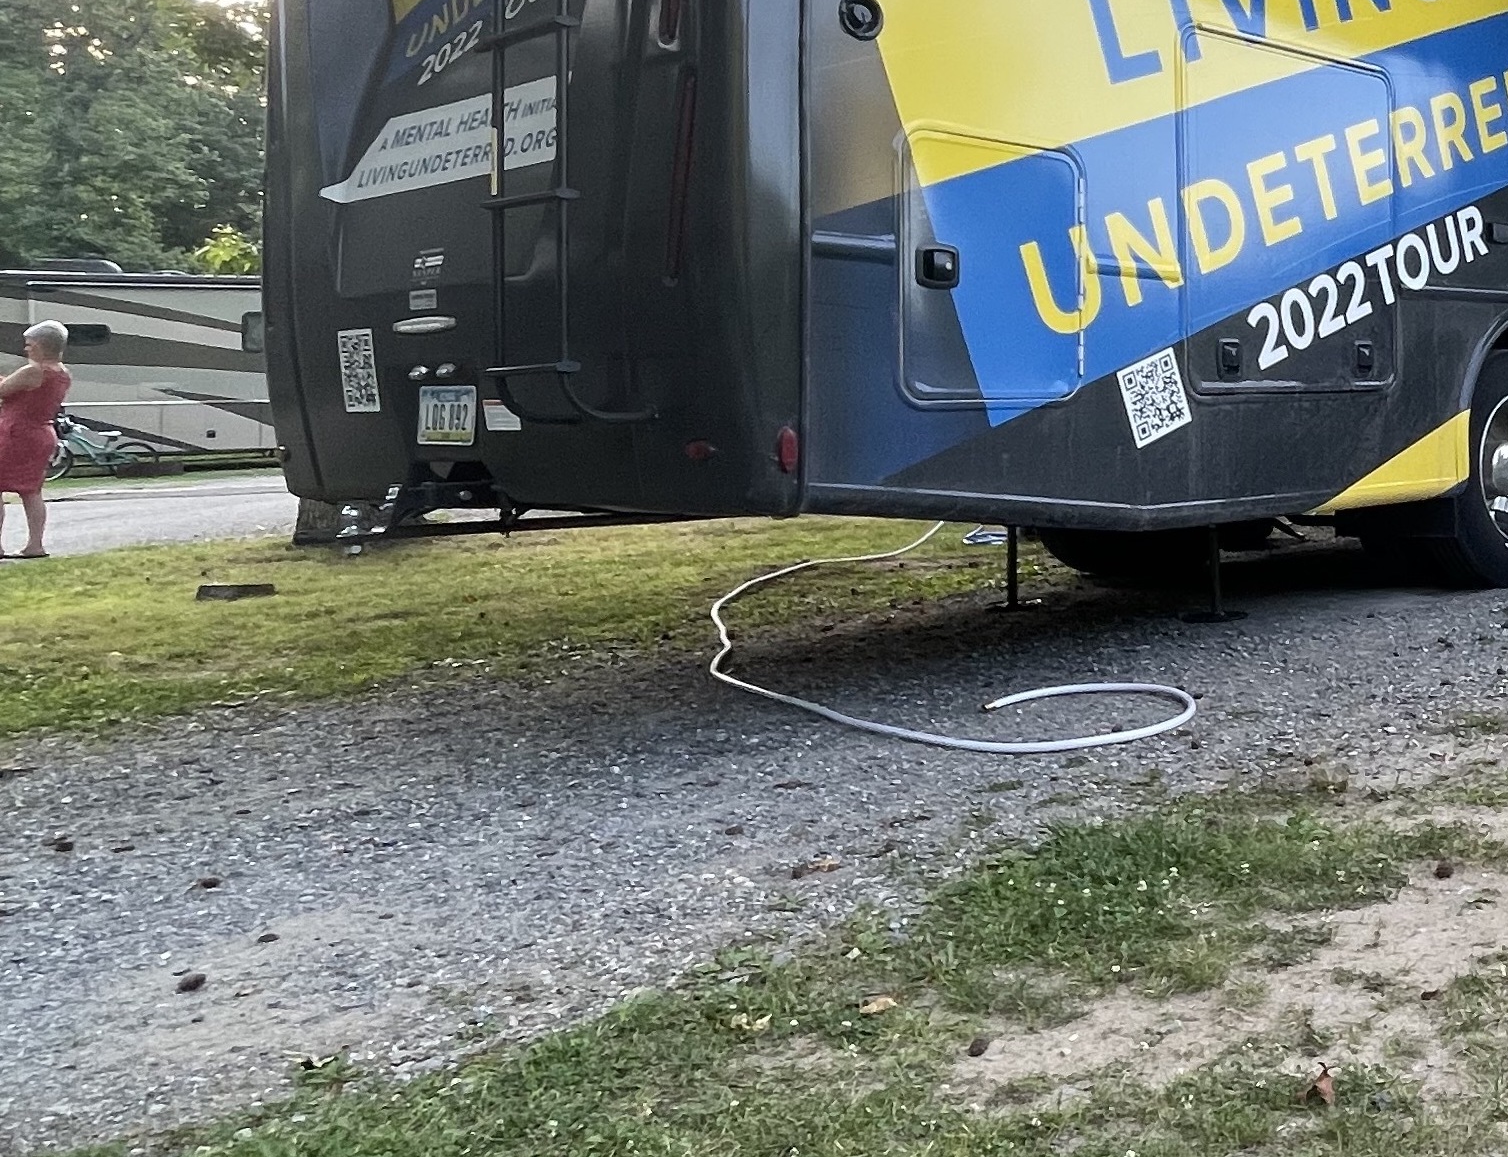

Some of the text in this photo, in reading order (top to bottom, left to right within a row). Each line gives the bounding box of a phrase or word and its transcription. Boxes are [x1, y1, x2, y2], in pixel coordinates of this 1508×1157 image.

[378, 137, 390, 153] A
[389, 117, 453, 150] MENTAL
[456, 97, 523, 135] HEATH
